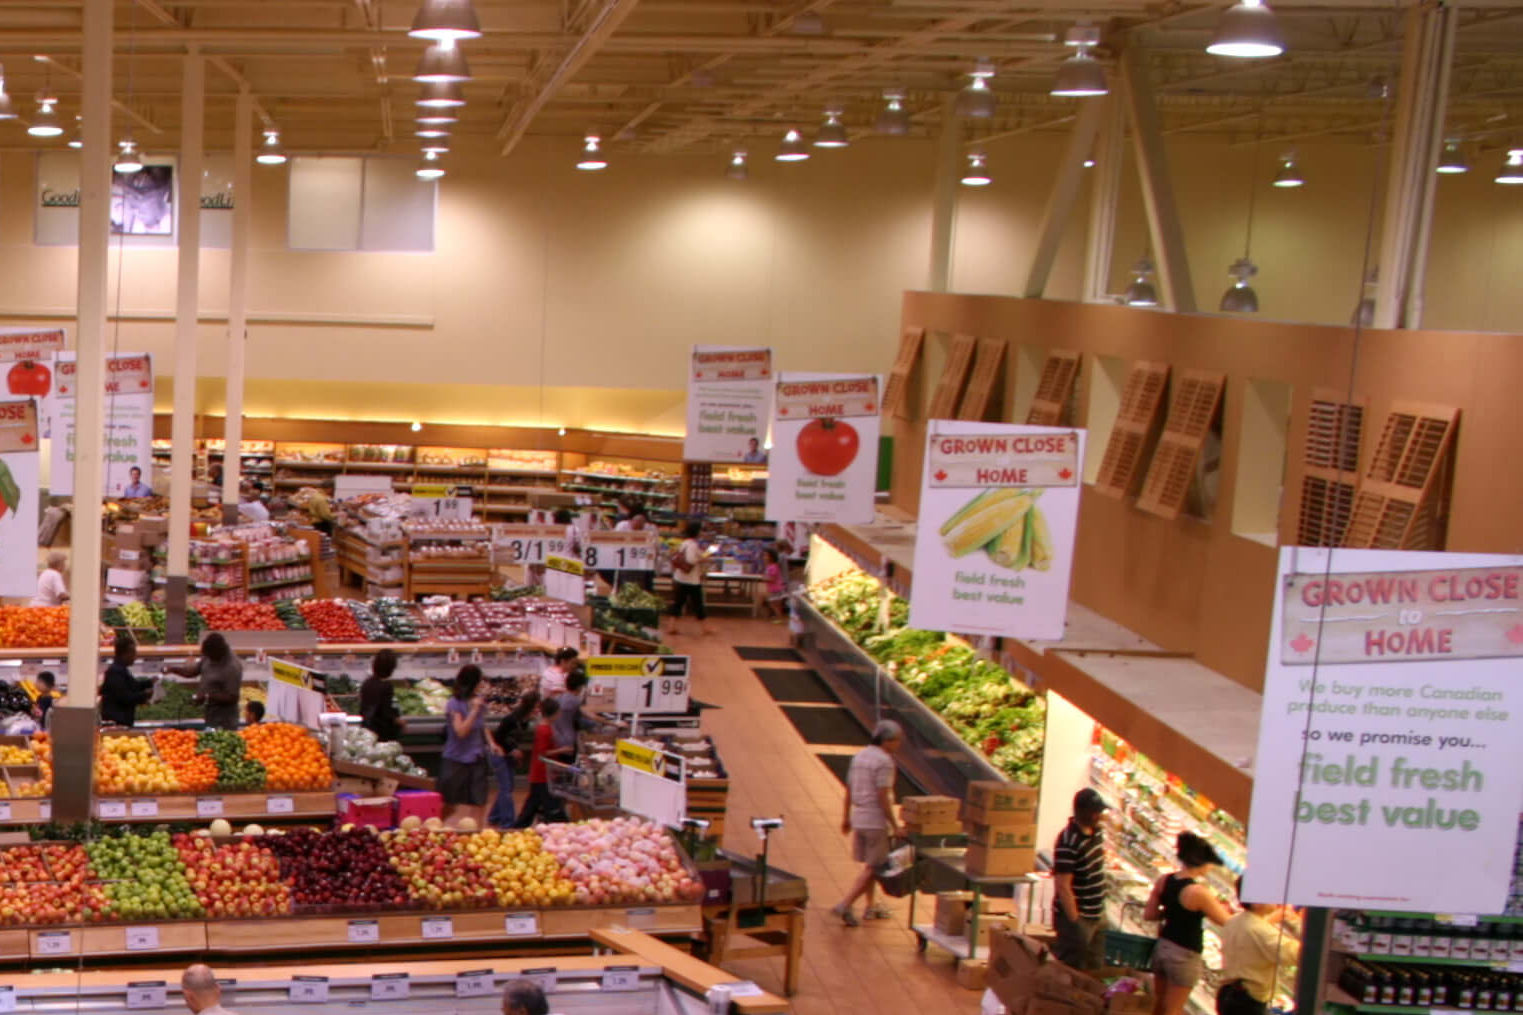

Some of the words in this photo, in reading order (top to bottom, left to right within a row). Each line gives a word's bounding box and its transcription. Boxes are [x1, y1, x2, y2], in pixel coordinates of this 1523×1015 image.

[107, 360, 143, 373] CLOSE
[783, 383, 829, 396] GROWN
[833, 381, 869, 394] CLOSE
[809, 404, 845, 415] HOME
[940, 438, 1007, 454] GROWN
[1012, 437, 1065, 453] CLOSE
[976, 468, 1029, 483] HOME
[954, 571, 986, 585] field
[990, 571, 1025, 588] fresh
[953, 588, 984, 601] best
[987, 590, 1024, 605] value
[1301, 577, 1418, 607] GROWN
[1427, 573, 1520, 602] CLOSE
[1399, 608, 1422, 624] to
[1364, 627, 1453, 656] HOME
[1299, 679, 1326, 694] We
[1332, 680, 1364, 698] buy
[1368, 685, 1413, 699] more
[1420, 683, 1504, 701] Canadian
[1287, 700, 1357, 715] produce
[1363, 702, 1401, 716] than
[1406, 706, 1471, 720] anyone
[1475, 706, 1509, 721] else
[1302, 730, 1321, 741] so
[1328, 731, 1354, 742] we
[1360, 729, 1433, 747] promise
[1438, 734, 1487, 749] you...
[1298, 752, 1379, 787] field
[1390, 756, 1484, 792] fresh
[1293, 790, 1371, 826] best
[1381, 796, 1481, 832] value
